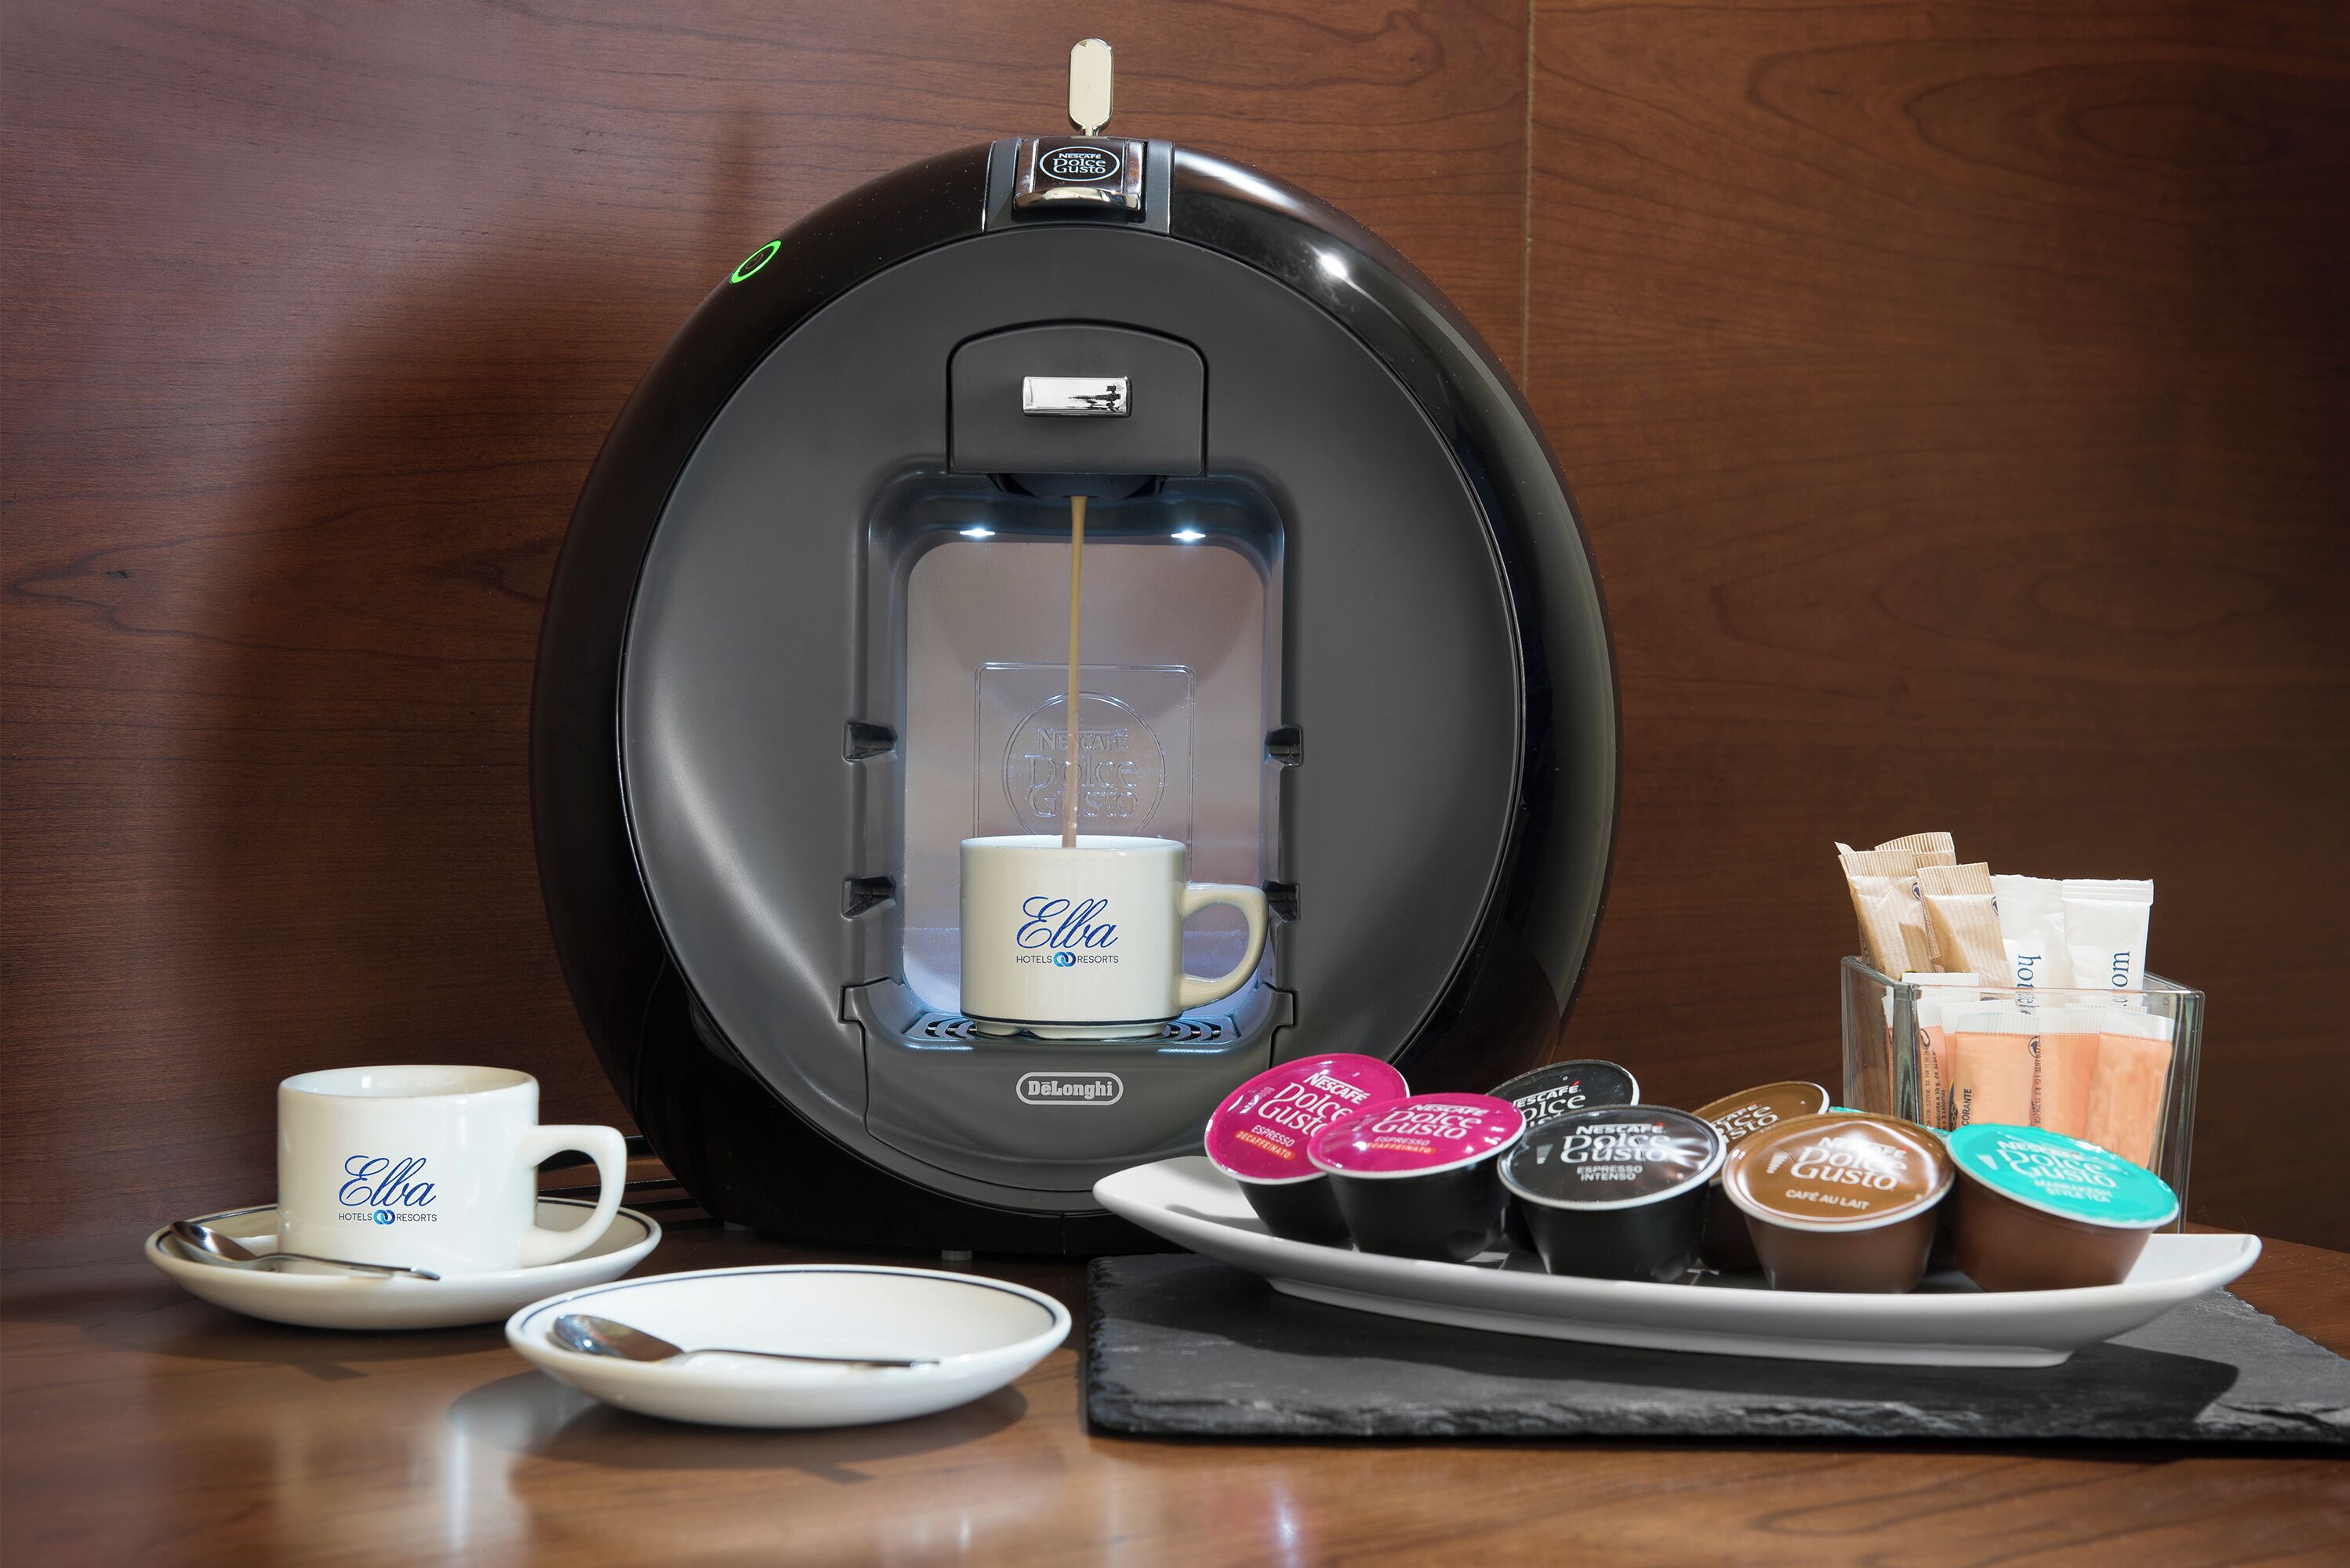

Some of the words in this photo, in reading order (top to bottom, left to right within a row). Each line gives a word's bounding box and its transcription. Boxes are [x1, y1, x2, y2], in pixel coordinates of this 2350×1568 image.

[1053, 158, 1106, 167] Dolce
[1053, 165, 1106, 174] Gusto
[1016, 896, 1118, 949] Elba
[1016, 955, 1052, 964] HOTELS
[1077, 955, 1119, 964] RESORTS
[1303, 1073, 1371, 1104] NESCAFÉ
[1513, 1081, 1582, 1108] ESCAFÉ
[1273, 1082, 1353, 1122] Dolce
[1522, 1094, 1585, 1121] olce
[1382, 1111, 1482, 1129] Dolce
[1576, 1123, 1665, 1135] NESCAFÉ
[1251, 1125, 1295, 1148] ESPRESSO
[1372, 1121, 1467, 1139] Gusto
[1237, 1131, 1291, 1158] DECAFFEINATO
[1367, 1142, 1432, 1154] ECAFFEINATO
[1374, 1137, 1430, 1146] ESPRESSO
[1564, 1133, 1670, 1150] Dolce
[1818, 1137, 1909, 1159] NEAFÉ
[1560, 1147, 1668, 1163] Gusto
[1996, 1149, 2107, 1176] Dolce
[1577, 1165, 1643, 1174] ESPRESSO
[1581, 1173, 1636, 1181] INTENSO
[1790, 1160, 1898, 1190] Gusto
[2010, 1162, 2117, 1188] Gusto
[339, 1155, 437, 1207] Elba
[1785, 1189, 1820, 1201] CAFÉ
[1819, 1194, 1840, 1205] AU
[1840, 1197, 1870, 1210] LAIT
[397, 1213, 438, 1221] RESORTS
